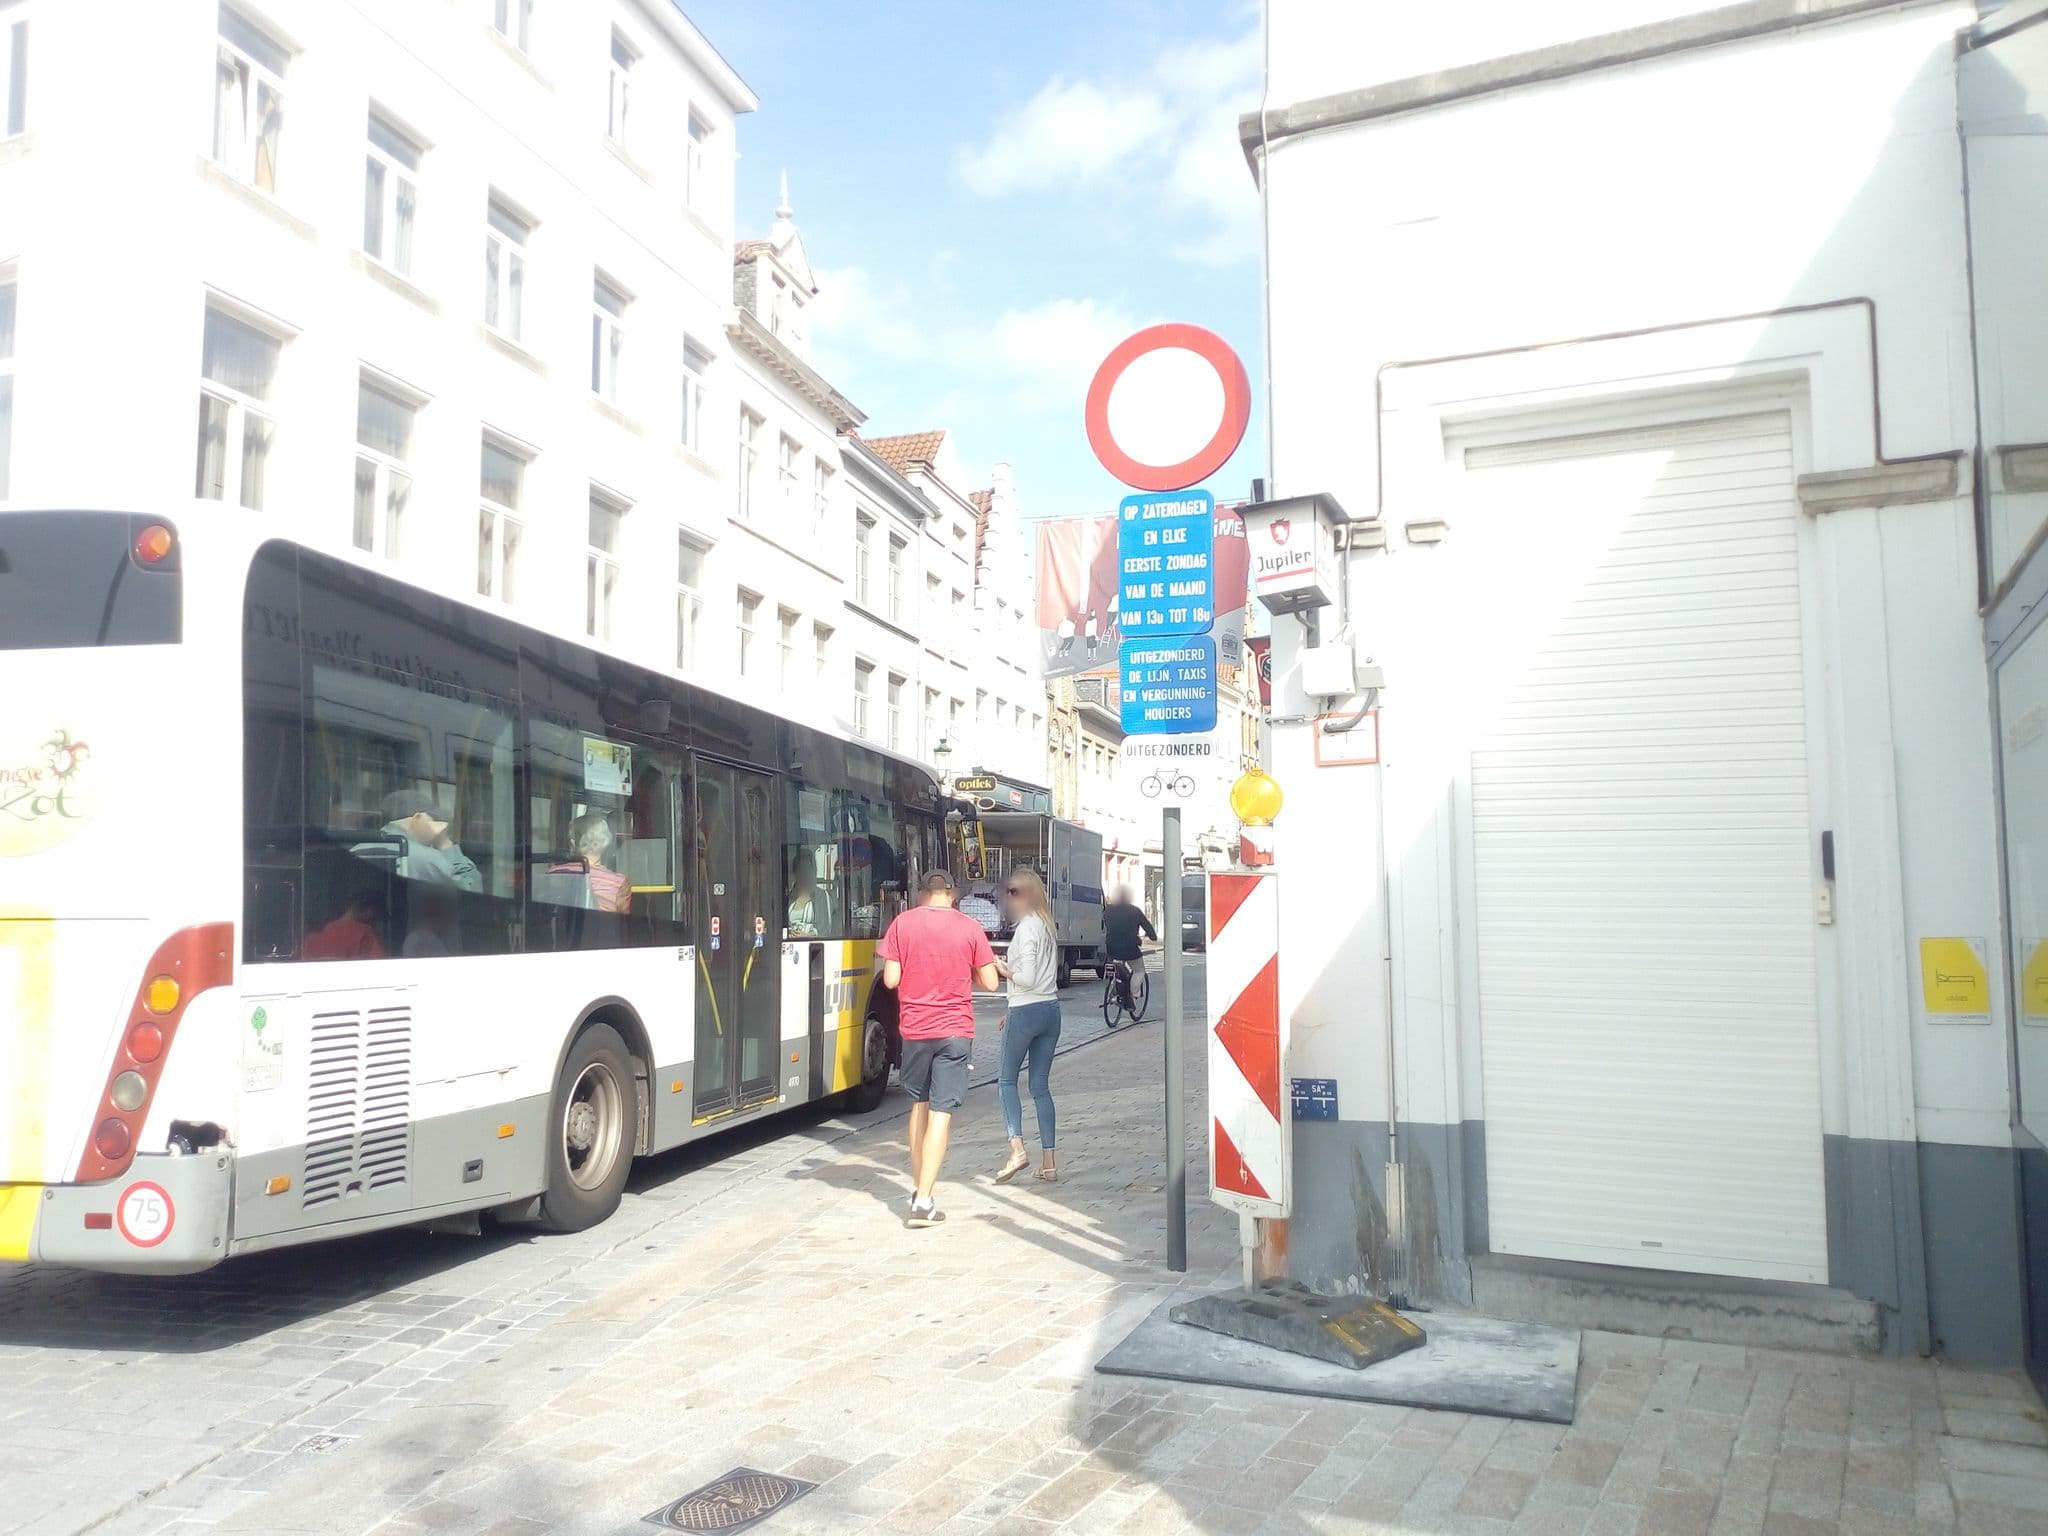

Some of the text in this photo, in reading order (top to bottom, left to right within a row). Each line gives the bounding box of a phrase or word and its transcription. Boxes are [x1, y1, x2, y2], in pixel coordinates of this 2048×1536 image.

[1124, 499, 1208, 521] OP ZATERDAGEN
[1143, 528, 1188, 546] EN ELKE
[1124, 553, 1207, 574] EERSTE ZONDAG
[1258, 550, 1312, 573] Jupiler
[1125, 580, 1206, 600] VAN DE MAAND
[1121, 607, 1210, 626] VAN 13u TOT 18u
[1130, 648, 1205, 665] UITGEZONDERD
[1128, 667, 1207, 684] DE LIJN, TAXIS
[1123, 687, 1213, 703] EN VERGUNNING-
[1144, 706, 1192, 721] HOUDERS
[1126, 743, 1211, 757] UITGEZONDERD
[131, 1198, 161, 1224] 75
